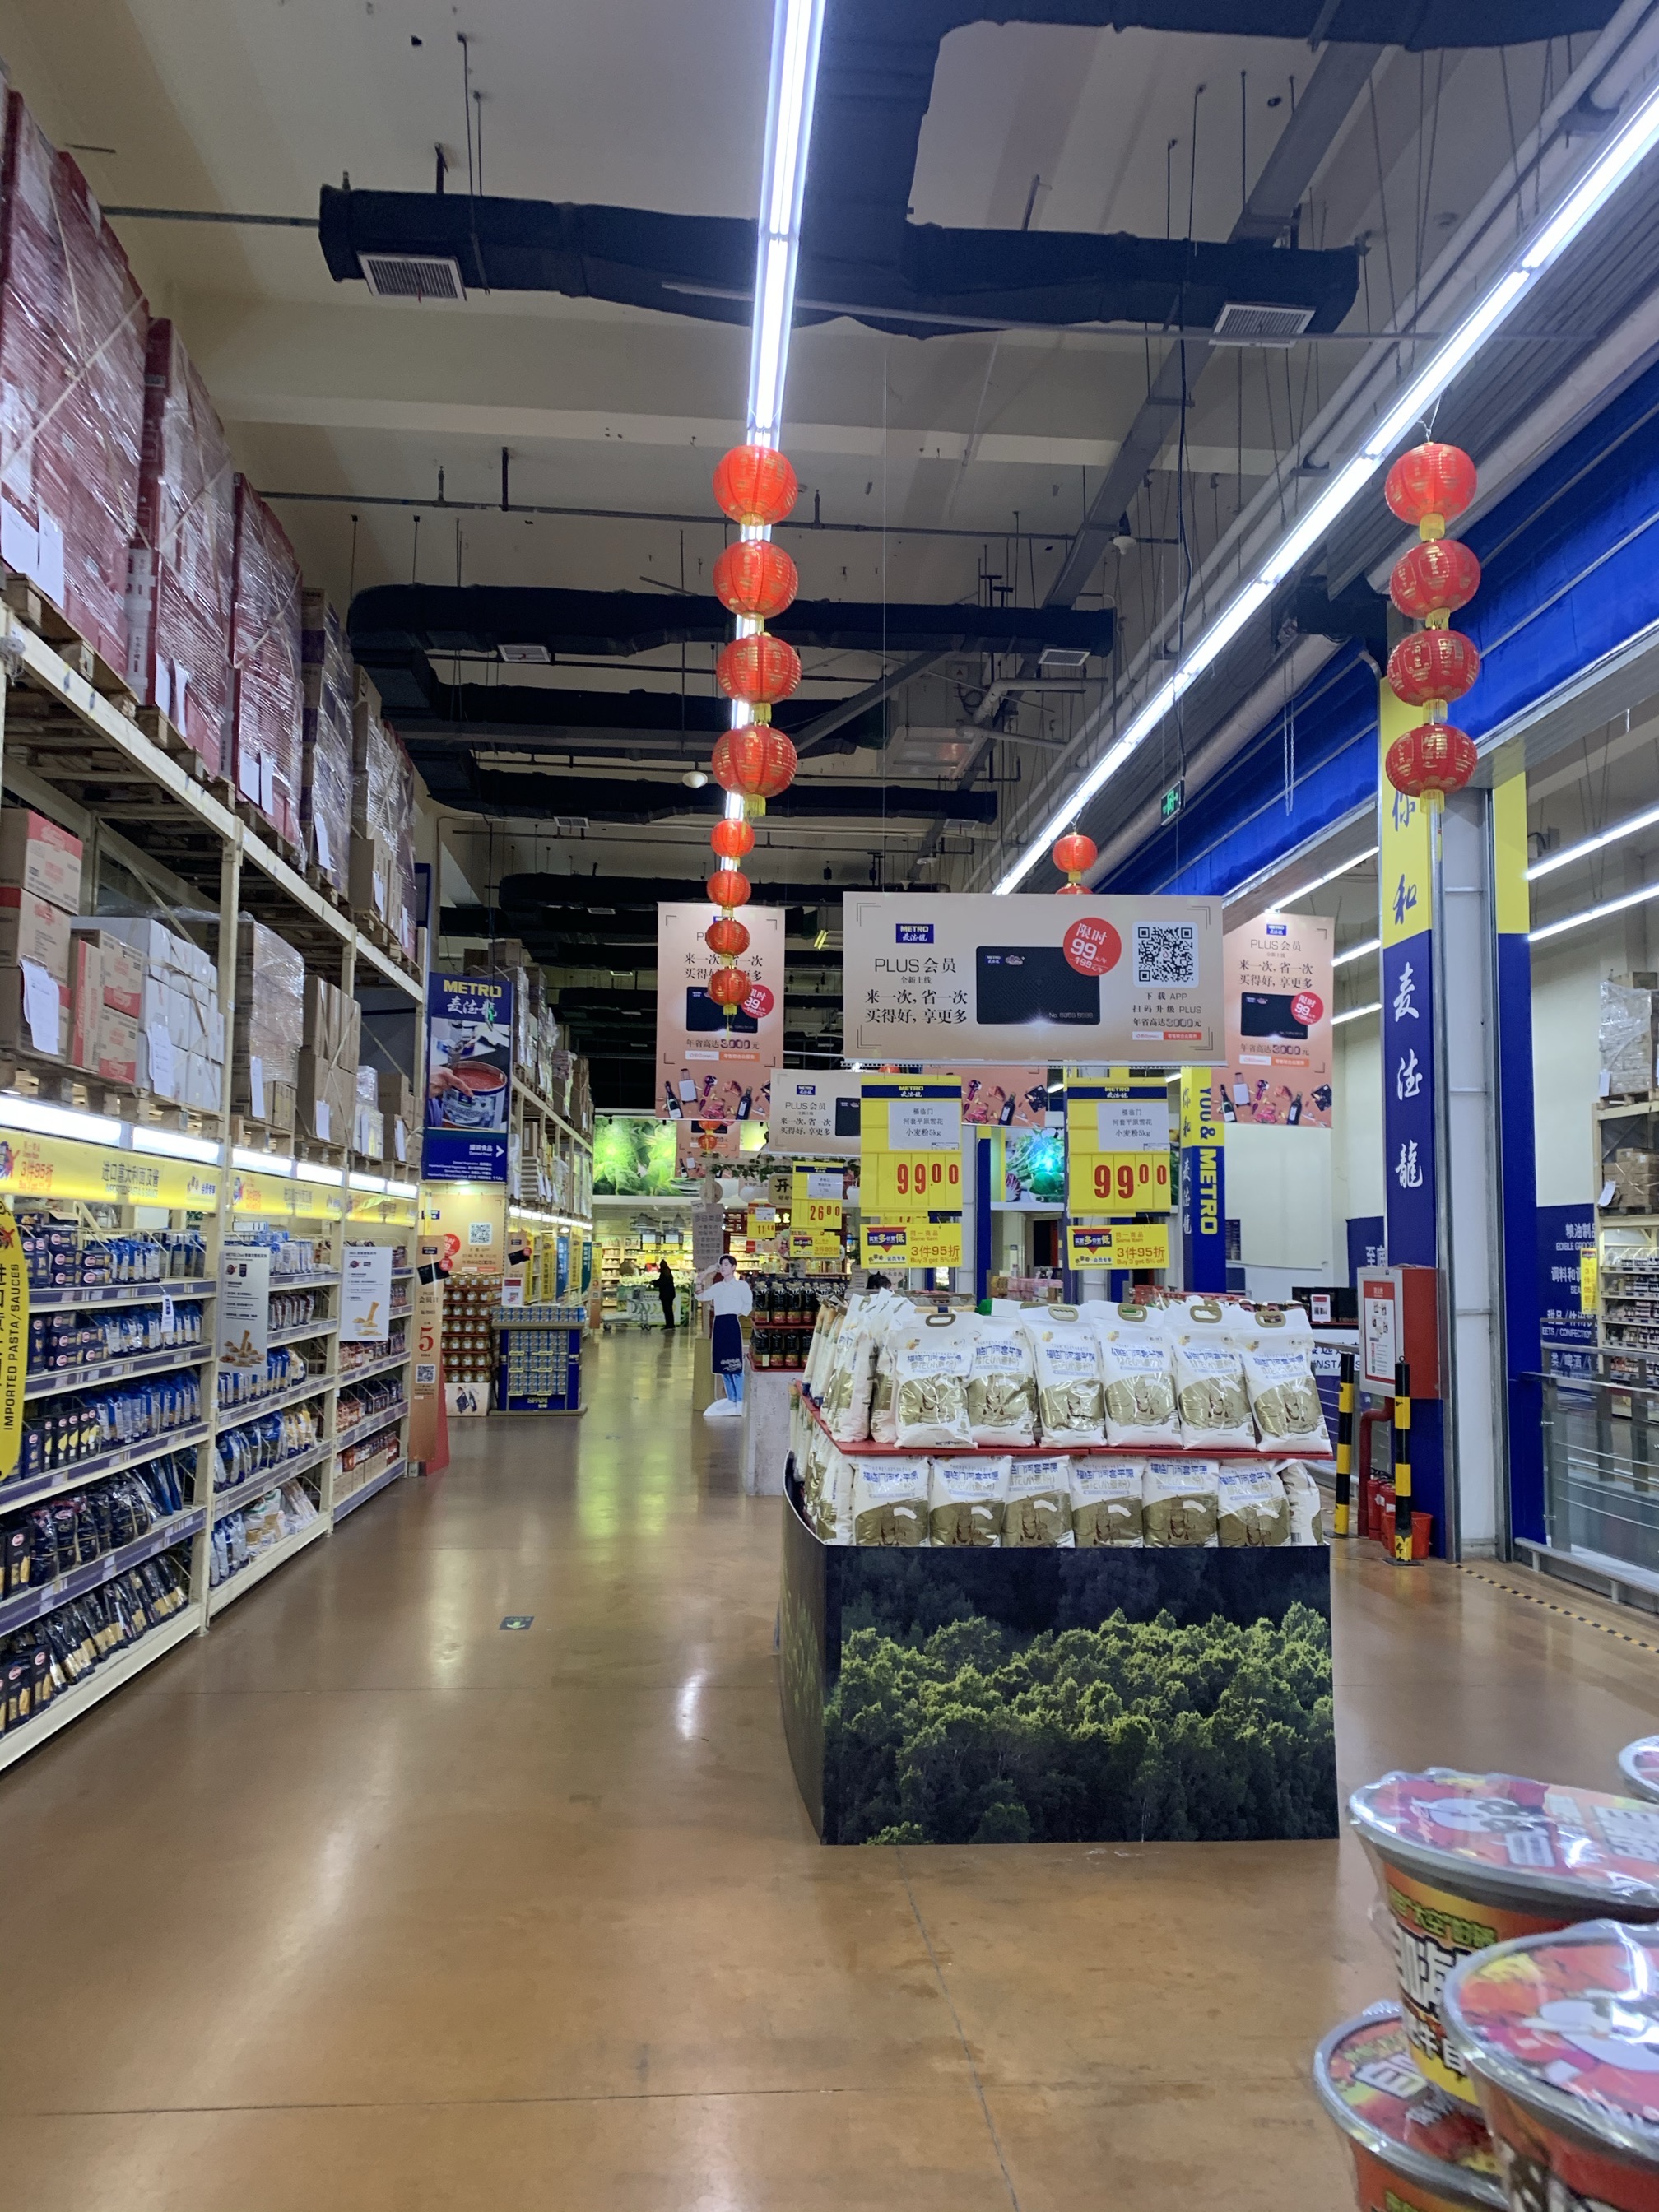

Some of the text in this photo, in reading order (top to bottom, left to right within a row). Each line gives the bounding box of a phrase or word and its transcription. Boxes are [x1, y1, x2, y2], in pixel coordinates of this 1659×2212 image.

[1076, 923, 1108, 946] 限时
[1070, 938, 1098, 960] 99
[1250, 939, 1302, 952] PLUS 会员
[875, 957, 956, 974] PLUS 会员
[900, 976, 932, 984] 全新上线
[443, 979, 502, 998] METRO
[1146, 992, 1188, 1001] 下载 APP
[1298, 994, 1317, 1008] 限时
[1132, 1005, 1202, 1014] 扫码升级 PLUS
[1294, 1002, 1311, 1015] 99
[785, 1101, 826, 1111] PLUS 会员
[913, 1108, 934, 1116] 福临门
[903, 1118, 944, 1126] 河套平原雪花
[906, 1128, 941, 1137] 小麦粉5kg
[1115, 1129, 1151, 1138] 小麦粉5kg
[1199, 1148, 1218, 1235] METRO
[911, 1244, 960, 1257] 3件95折
[1117, 1246, 1165, 1259] 3件95折
[1555, 1242, 1574, 1251] EDIBLE
[419, 1327, 434, 1351] 5
[3, 1263, 20, 1431] IMPORTED PASTA/SAUCES
